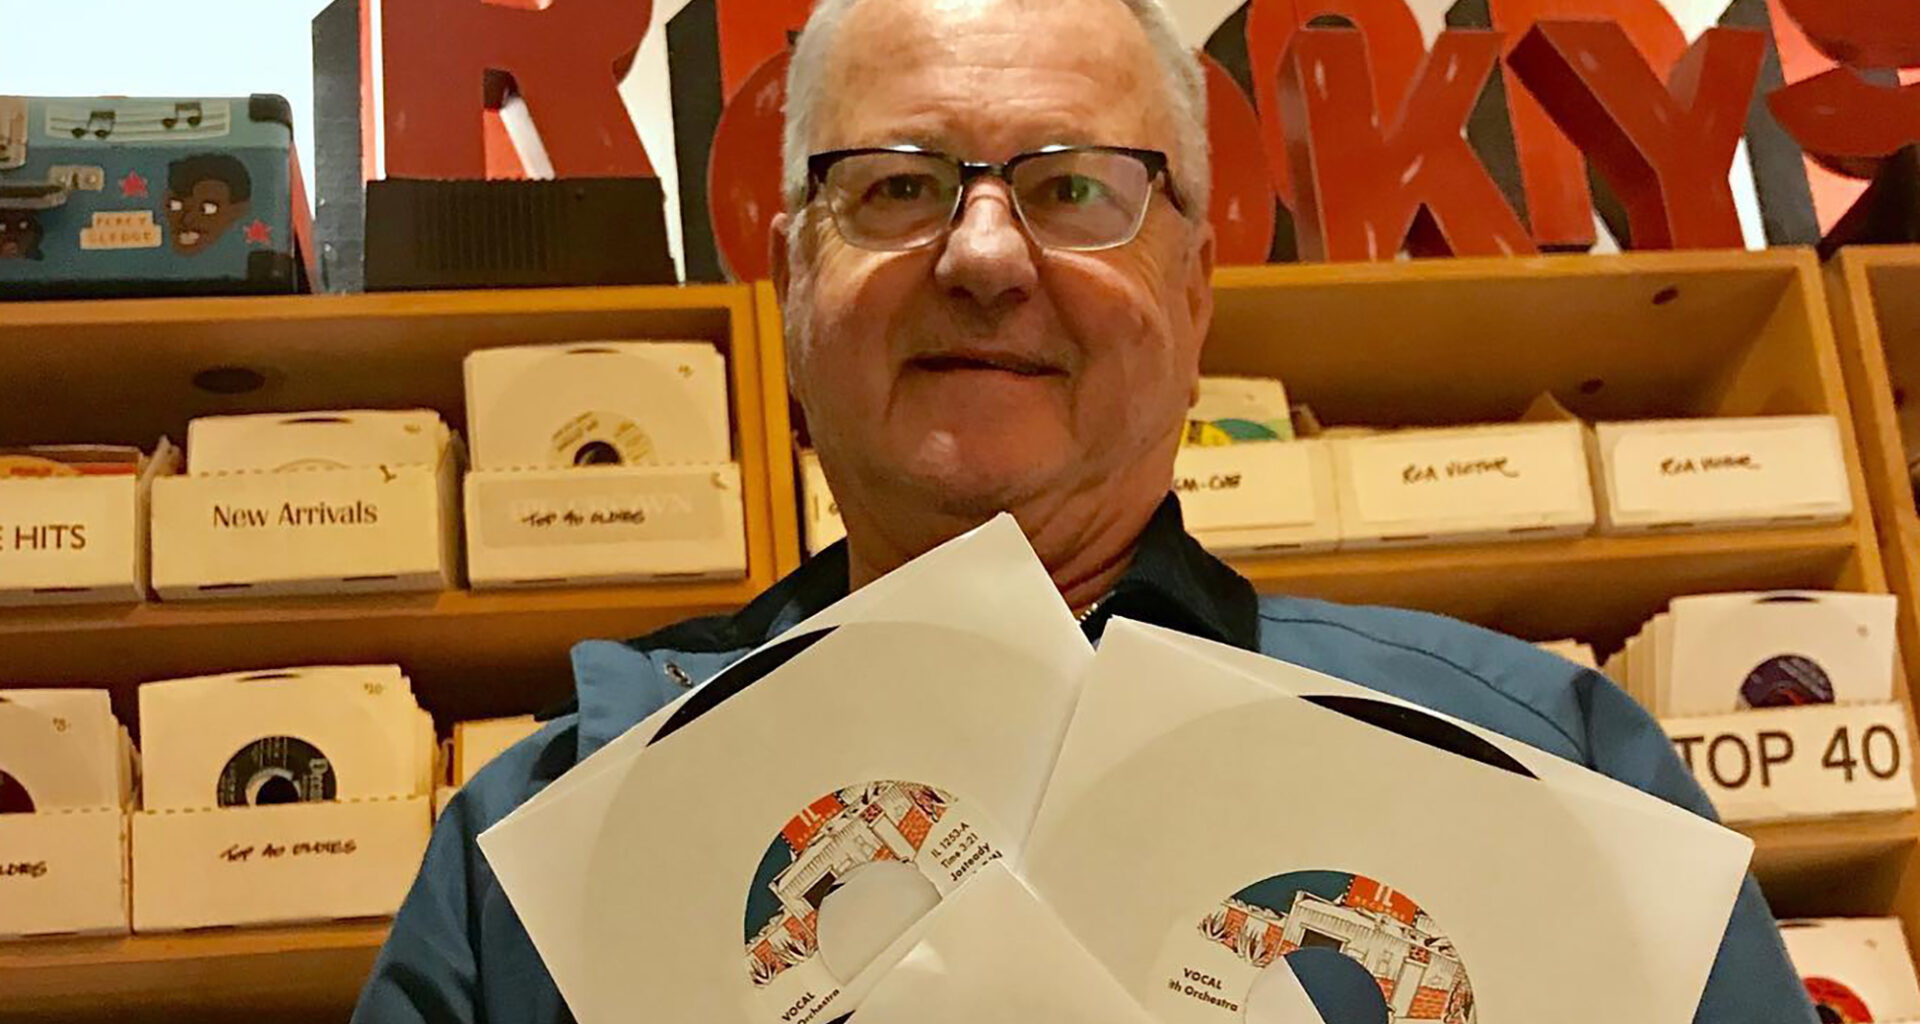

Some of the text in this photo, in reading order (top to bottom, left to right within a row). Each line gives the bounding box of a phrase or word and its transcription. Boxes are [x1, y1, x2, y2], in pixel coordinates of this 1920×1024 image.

[213, 499, 378, 529] New Arrivals
[15, 524, 87, 550] HITS
[1670, 724, 1901, 790] TOP 40
[1183, 967, 1222, 990] VOCAL
[781, 991, 816, 1022] VOCAL
[797, 988, 840, 1024] Orchestra
[1184, 985, 1239, 1012] Orchestra
